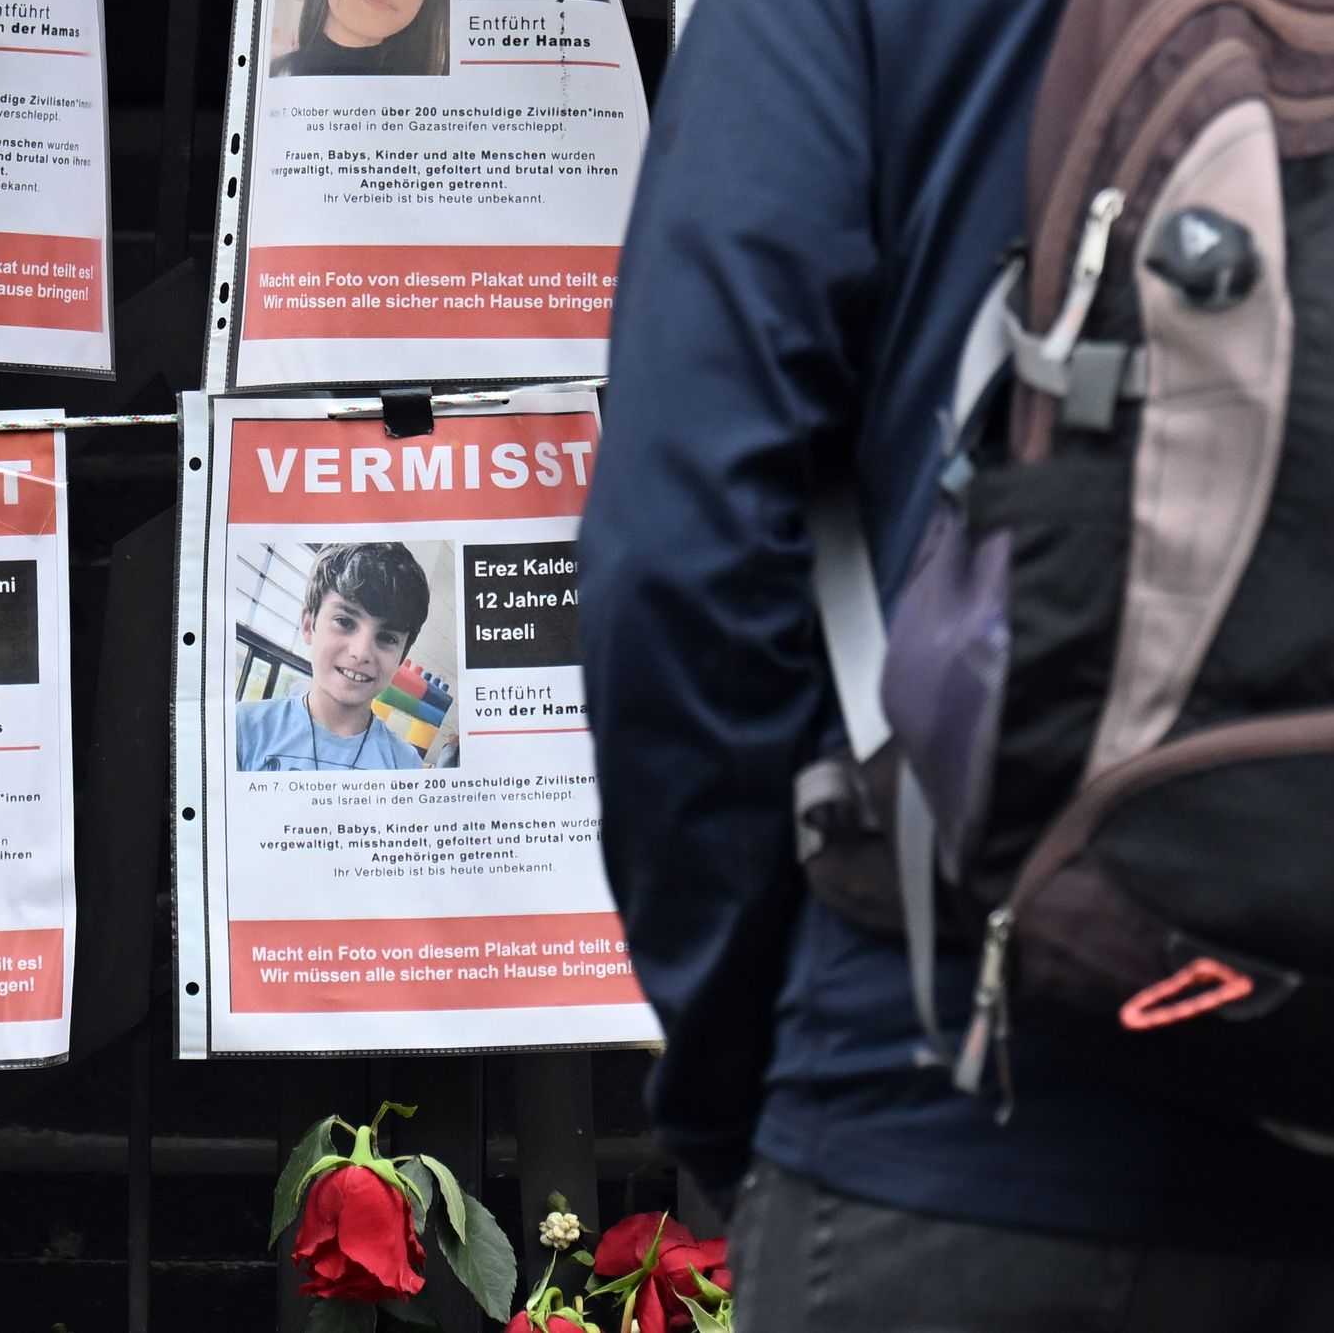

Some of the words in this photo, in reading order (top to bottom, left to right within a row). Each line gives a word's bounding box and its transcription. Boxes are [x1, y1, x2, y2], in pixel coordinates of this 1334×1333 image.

[469, 16, 545, 30] Entführt
[469, 37, 495, 46] von
[502, 35, 529, 46] der
[536, 35, 590, 47] Hamas
[257, 441, 592, 493] VERMISST
[475, 561, 518, 577] Erez
[476, 592, 498, 609] 12
[503, 591, 557, 608] Jahre
[562, 590, 578, 606] Al
[476, 623, 534, 641] Israeli
